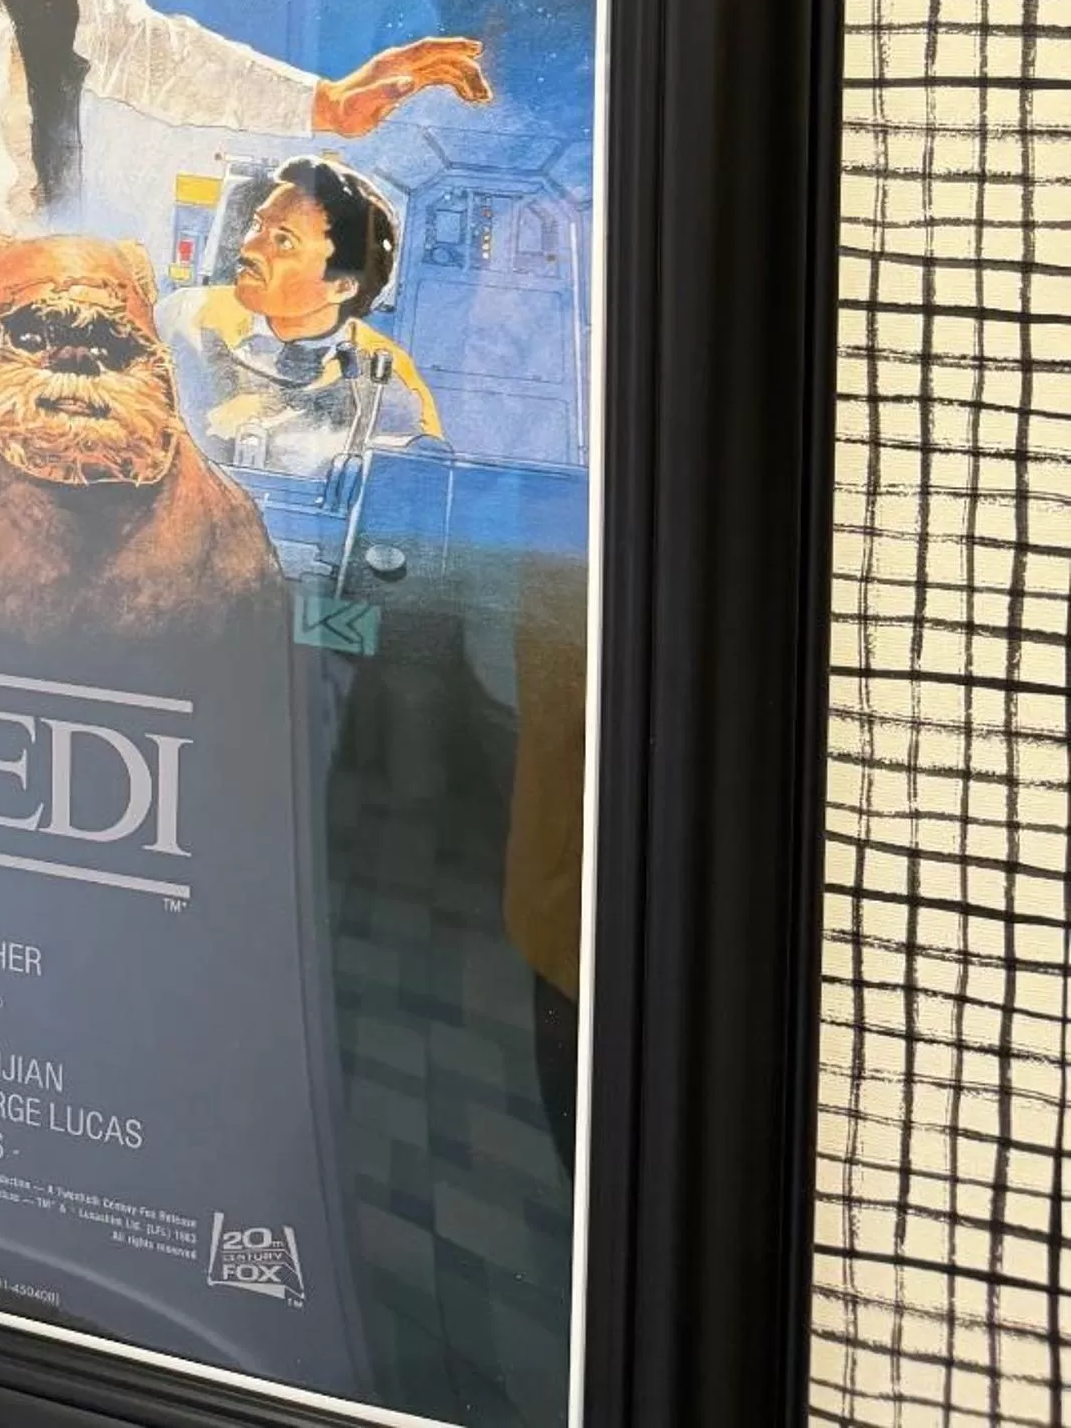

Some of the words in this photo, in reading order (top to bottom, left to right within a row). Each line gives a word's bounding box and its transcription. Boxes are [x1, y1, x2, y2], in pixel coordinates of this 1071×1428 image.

[49, 1101, 143, 1149] LUCAS
[223, 1251, 283, 1262] CENTURY
[222, 1263, 283, 1283] FOX
